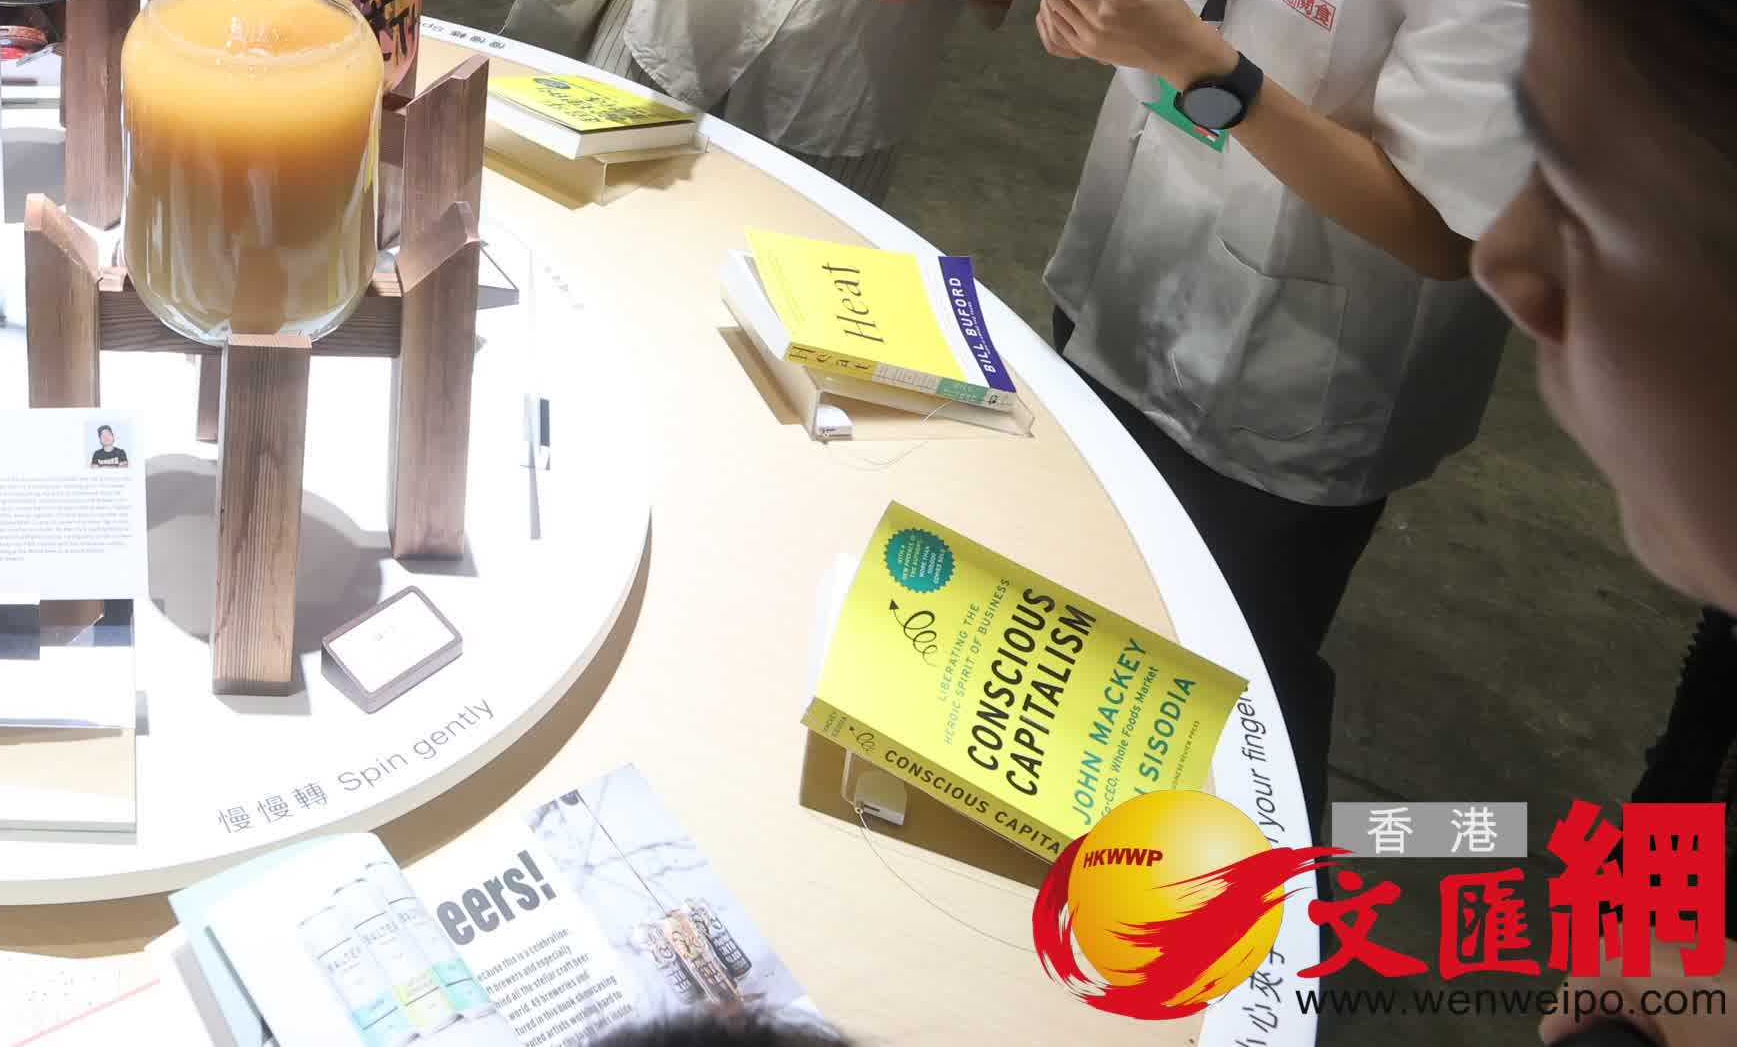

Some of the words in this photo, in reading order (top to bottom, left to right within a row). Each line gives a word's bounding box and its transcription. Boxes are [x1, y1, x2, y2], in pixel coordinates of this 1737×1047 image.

[821, 261, 885, 344] Heat
[949, 277, 978, 337] BUFORD
[788, 344, 873, 371] Heat
[973, 343, 996, 373] BILL
[938, 631, 968, 702] LIBERATING
[964, 602, 981, 627] THE
[944, 699, 962, 746] HEROIC
[954, 655, 976, 698] SPIRIT
[969, 633, 983, 655] OF
[978, 578, 1011, 635] BUSINESS
[967, 587, 1056, 771] CONSCIOUS
[1006, 604, 1097, 797] CAPITALISM
[1071, 750, 1104, 826] JOHN
[1088, 637, 1148, 746] MACKEY
[1112, 739, 1129, 774] Whole
[1121, 704, 1142, 738] Foods
[1134, 665, 1160, 704] Market
[1138, 677, 1197, 783] SISODIA
[1236, 696, 1267, 762] finge
[337, 751, 409, 792] Spin
[412, 697, 496, 760] gently
[217, 782, 330, 834] 慢慢轉
[884, 749, 989, 815] CONSCIOUS
[994, 810, 1062, 854] CAPITA
[1250, 767, 1285, 833] your
[437, 848, 557, 948] eers!
[493, 971, 523, 992] brewers
[522, 963, 537, 976] and
[536, 944, 571, 969] especially
[502, 956, 517, 968] this
[540, 978, 576, 1003] breweries
[575, 971, 589, 983] and
[573, 952, 589, 966] beer
[543, 1007, 558, 1020] this
